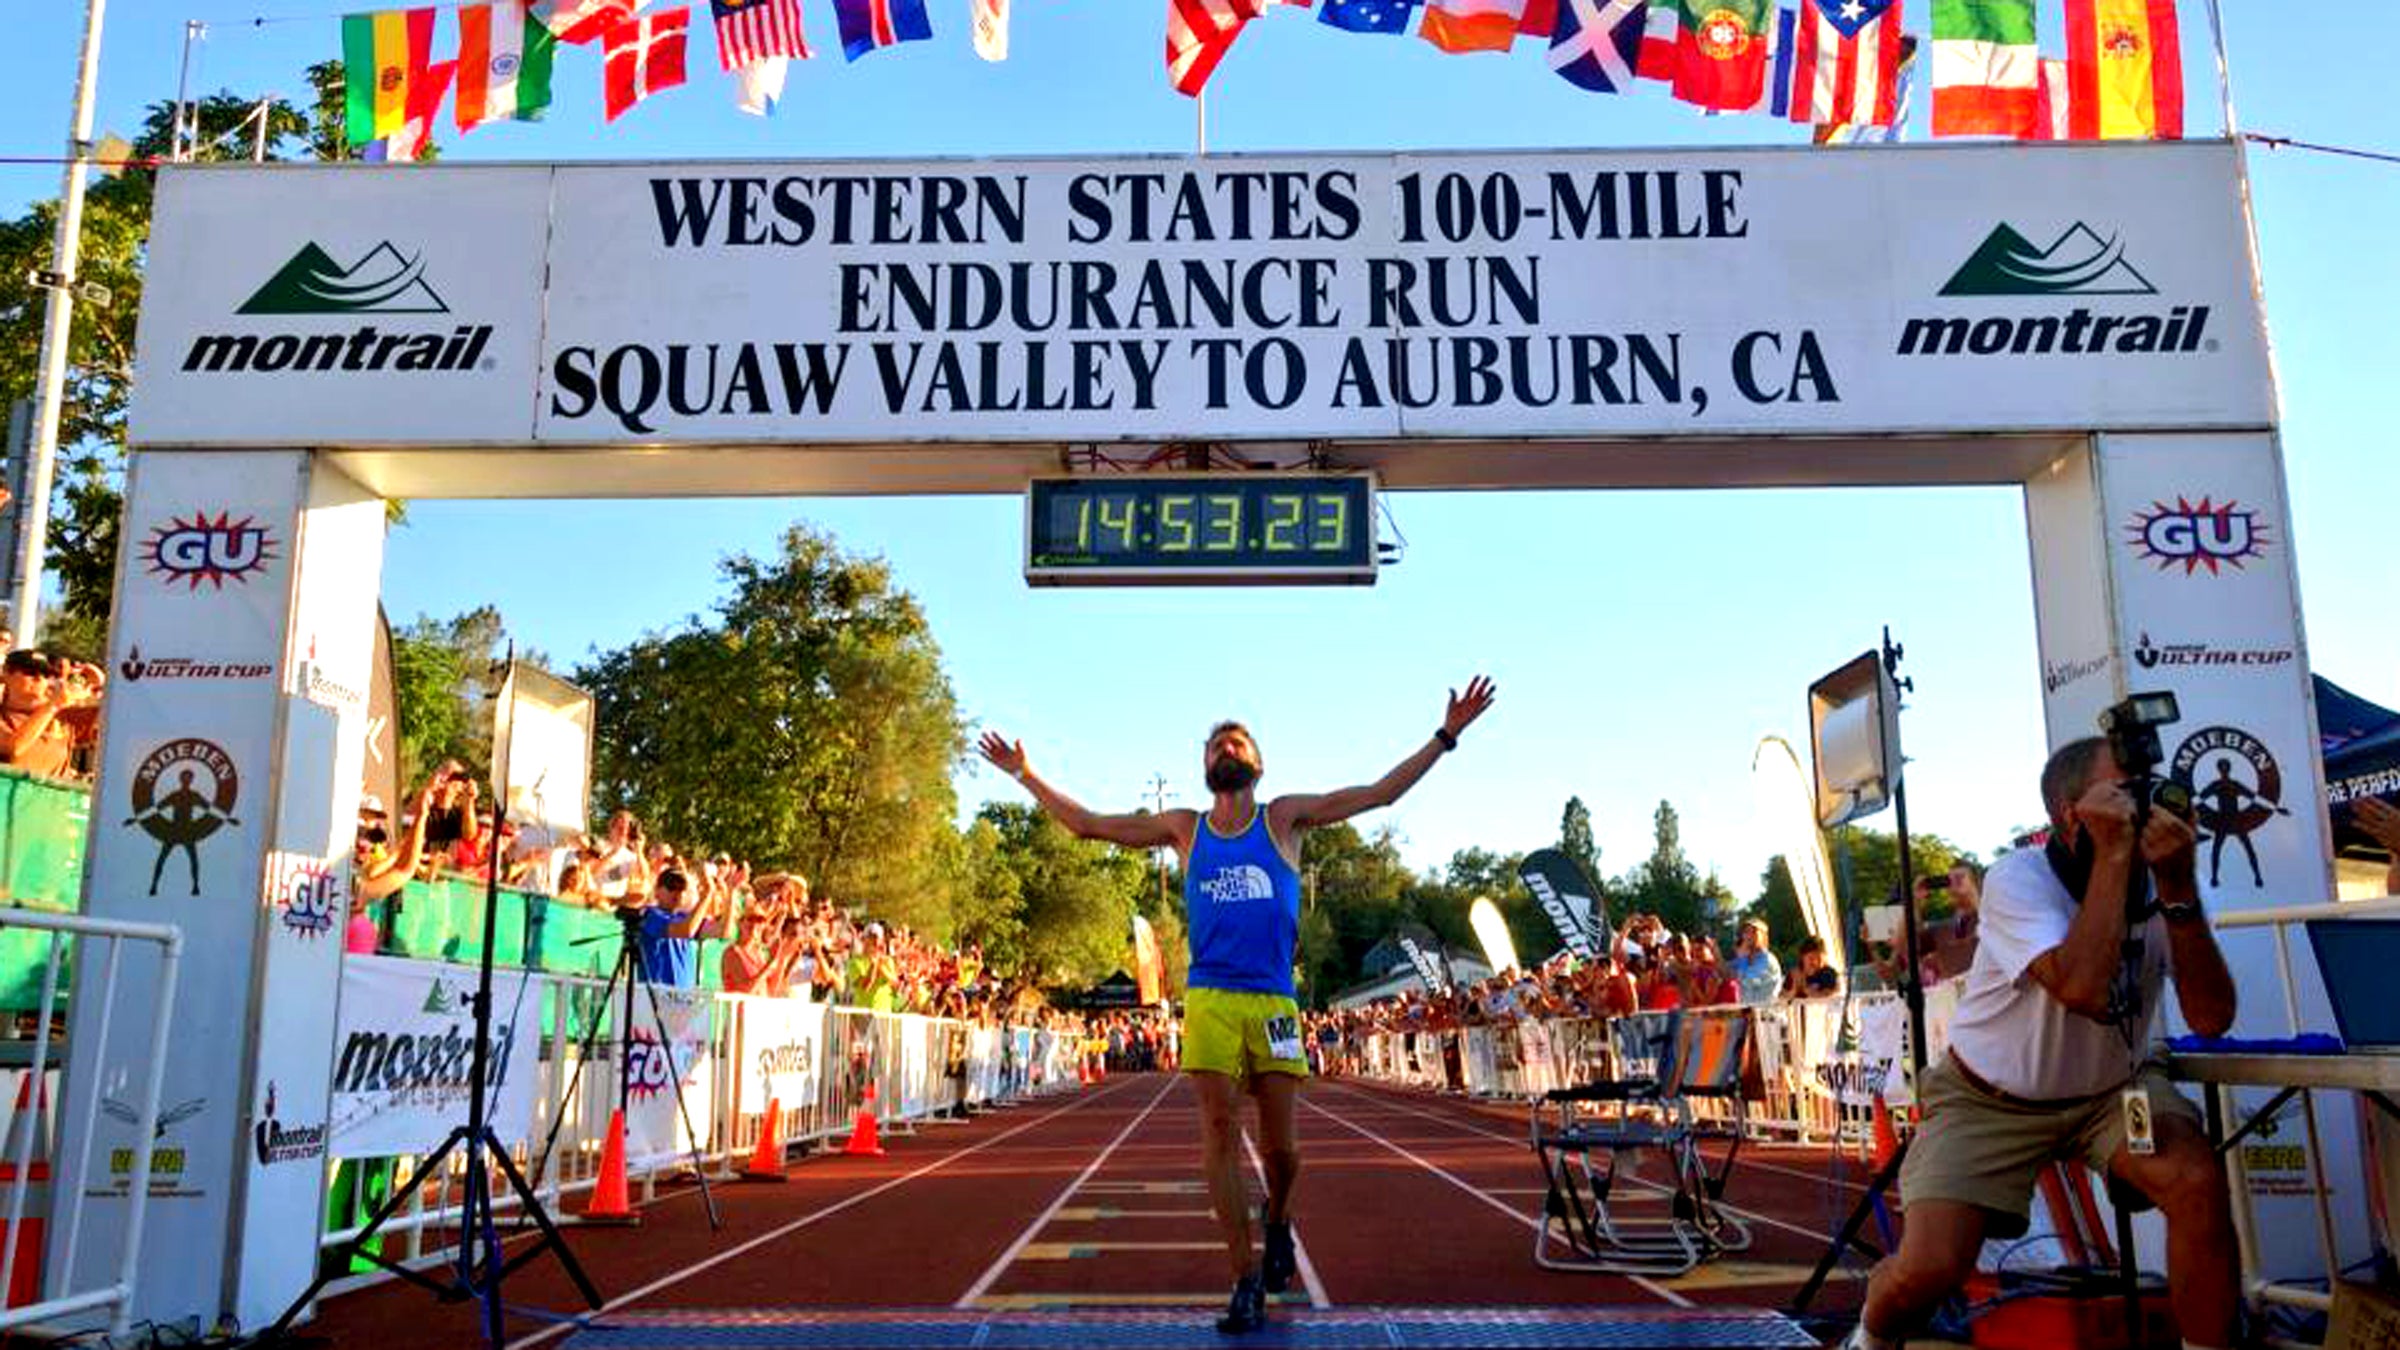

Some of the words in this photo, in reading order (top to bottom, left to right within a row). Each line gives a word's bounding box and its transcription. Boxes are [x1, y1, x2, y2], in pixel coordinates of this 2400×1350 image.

[649, 176, 1027, 247] WESTERN
[1068, 171, 1359, 242] STATES
[1396, 170, 1749, 242] 100-MILE
[837, 258, 1340, 332] ENDURANCE
[1367, 257, 1540, 328] RUN
[182, 325, 494, 372] montrail
[1897, 306, 2209, 355] montrail
[551, 342, 849, 433] SQUAW
[871, 340, 1169, 412] VALLEY
[1191, 337, 1307, 410] TO
[1330, 333, 1708, 417] AUBURN,
[1730, 330, 1840, 404] CA
[1077, 496, 1346, 550] 14:53.23
[2143, 512, 2251, 559] GU
[157, 528, 263, 573] GU
[223, 663, 273, 678] CUP
[2240, 650, 2292, 665] CUP
[142, 743, 234, 782] MOEBEN
[2175, 732, 2273, 771] MOEBEN
[1200, 879, 1248, 893] NORTH
[1219, 866, 1246, 879] THE
[1213, 889, 1247, 903] FACE
